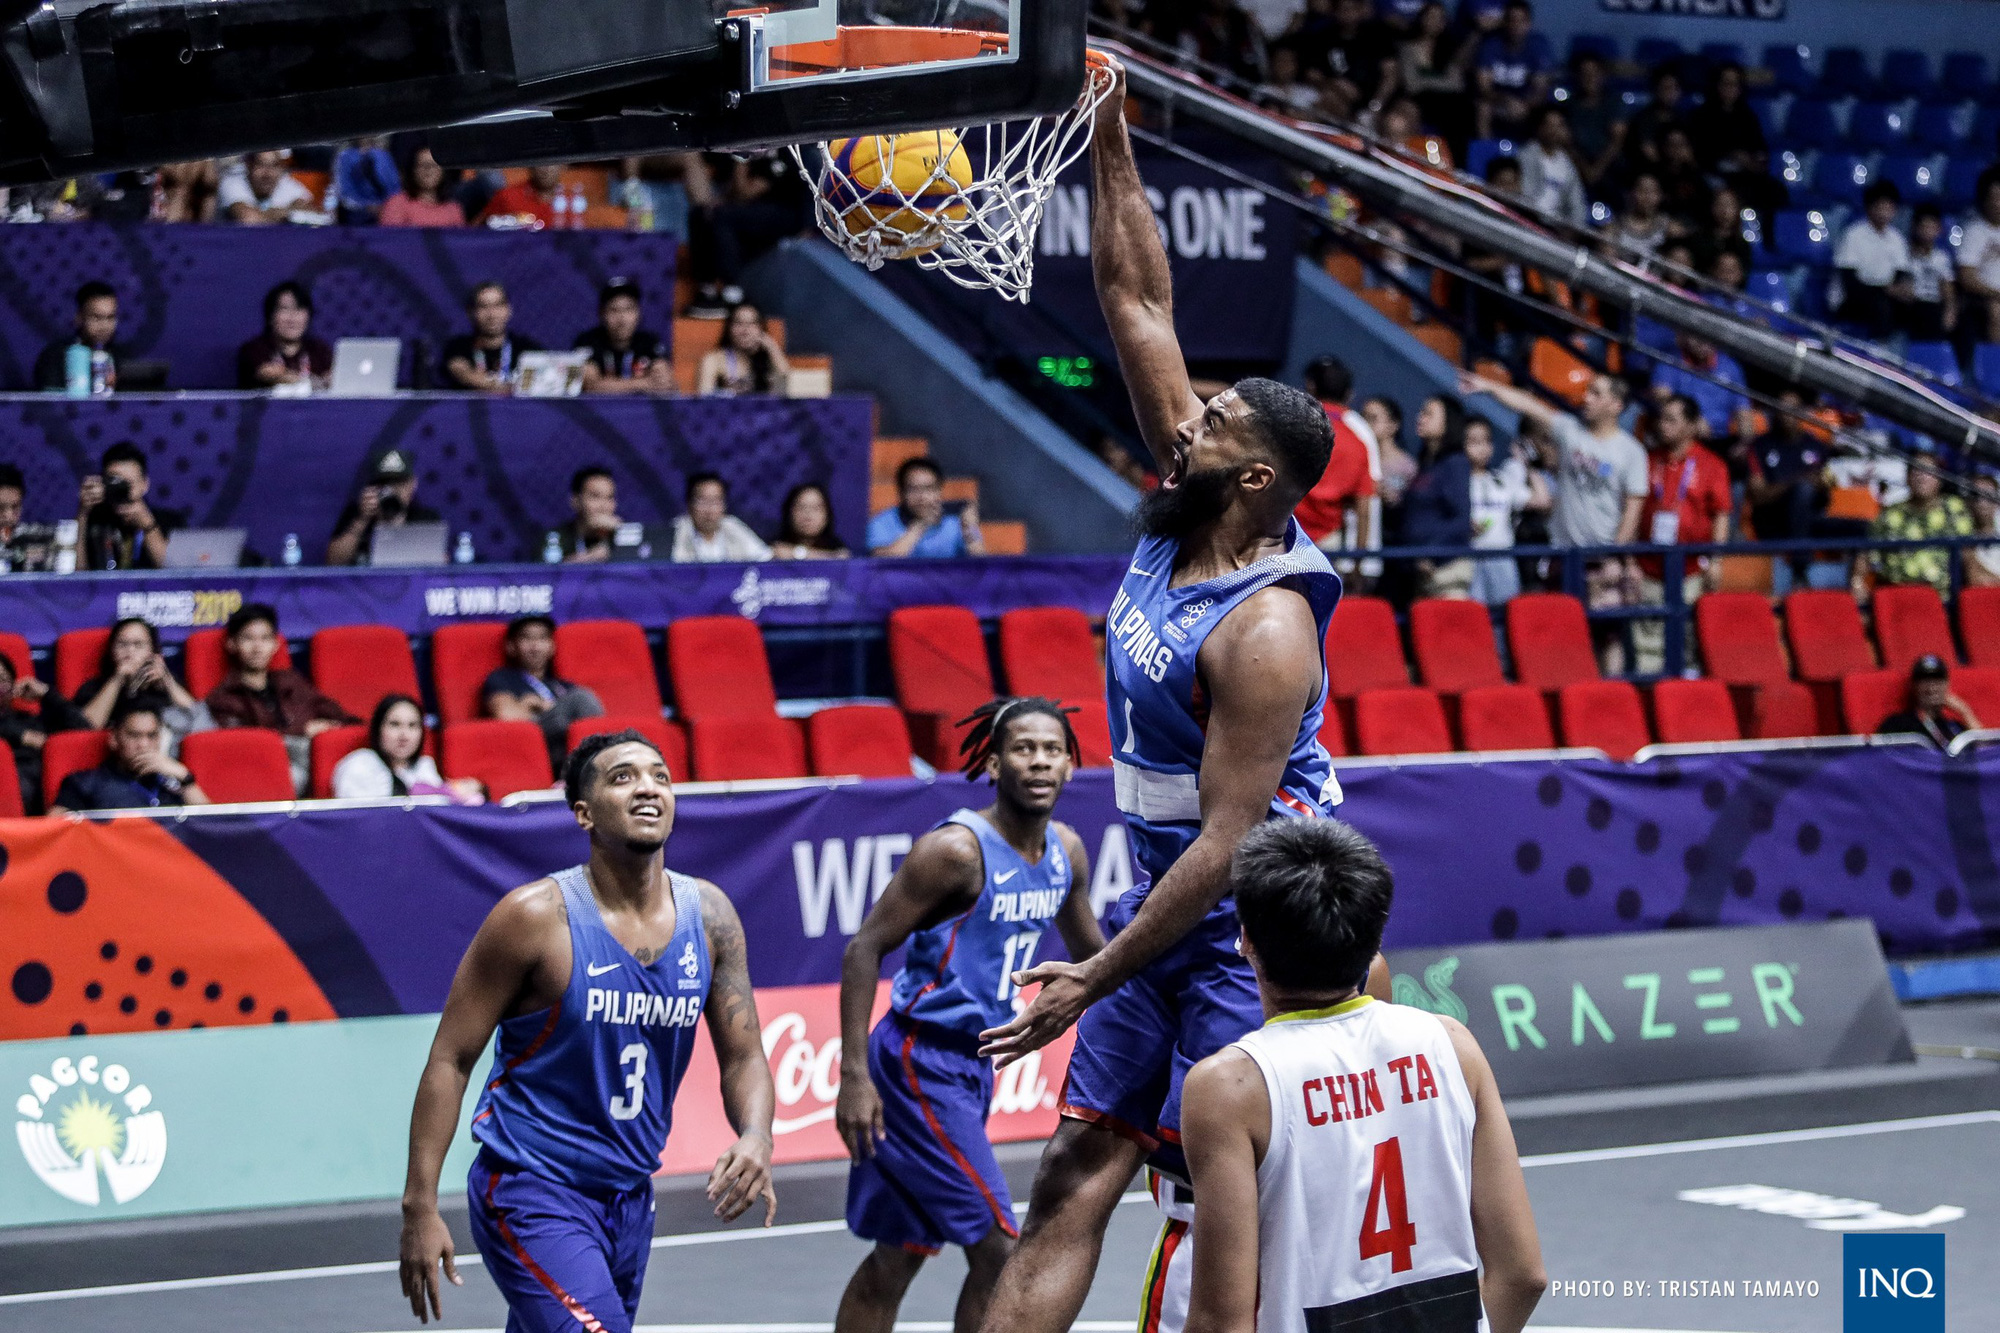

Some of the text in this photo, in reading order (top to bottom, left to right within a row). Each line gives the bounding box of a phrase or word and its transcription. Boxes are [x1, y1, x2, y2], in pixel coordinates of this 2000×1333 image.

[1170, 185, 1267, 261] ONE
[425, 584, 553, 616] WE WIN AS ONE
[1088, 823, 1136, 921] A
[996, 931, 1042, 1001] 17
[586, 988, 699, 1027] PILIPINAS
[1491, 962, 1804, 1051] RAZER
[16, 1055, 152, 1121] PAGCOR
[609, 1043, 648, 1120] 3
[1303, 1054, 1439, 1127] CHIN TA
[1359, 1136, 1417, 1273] 4
